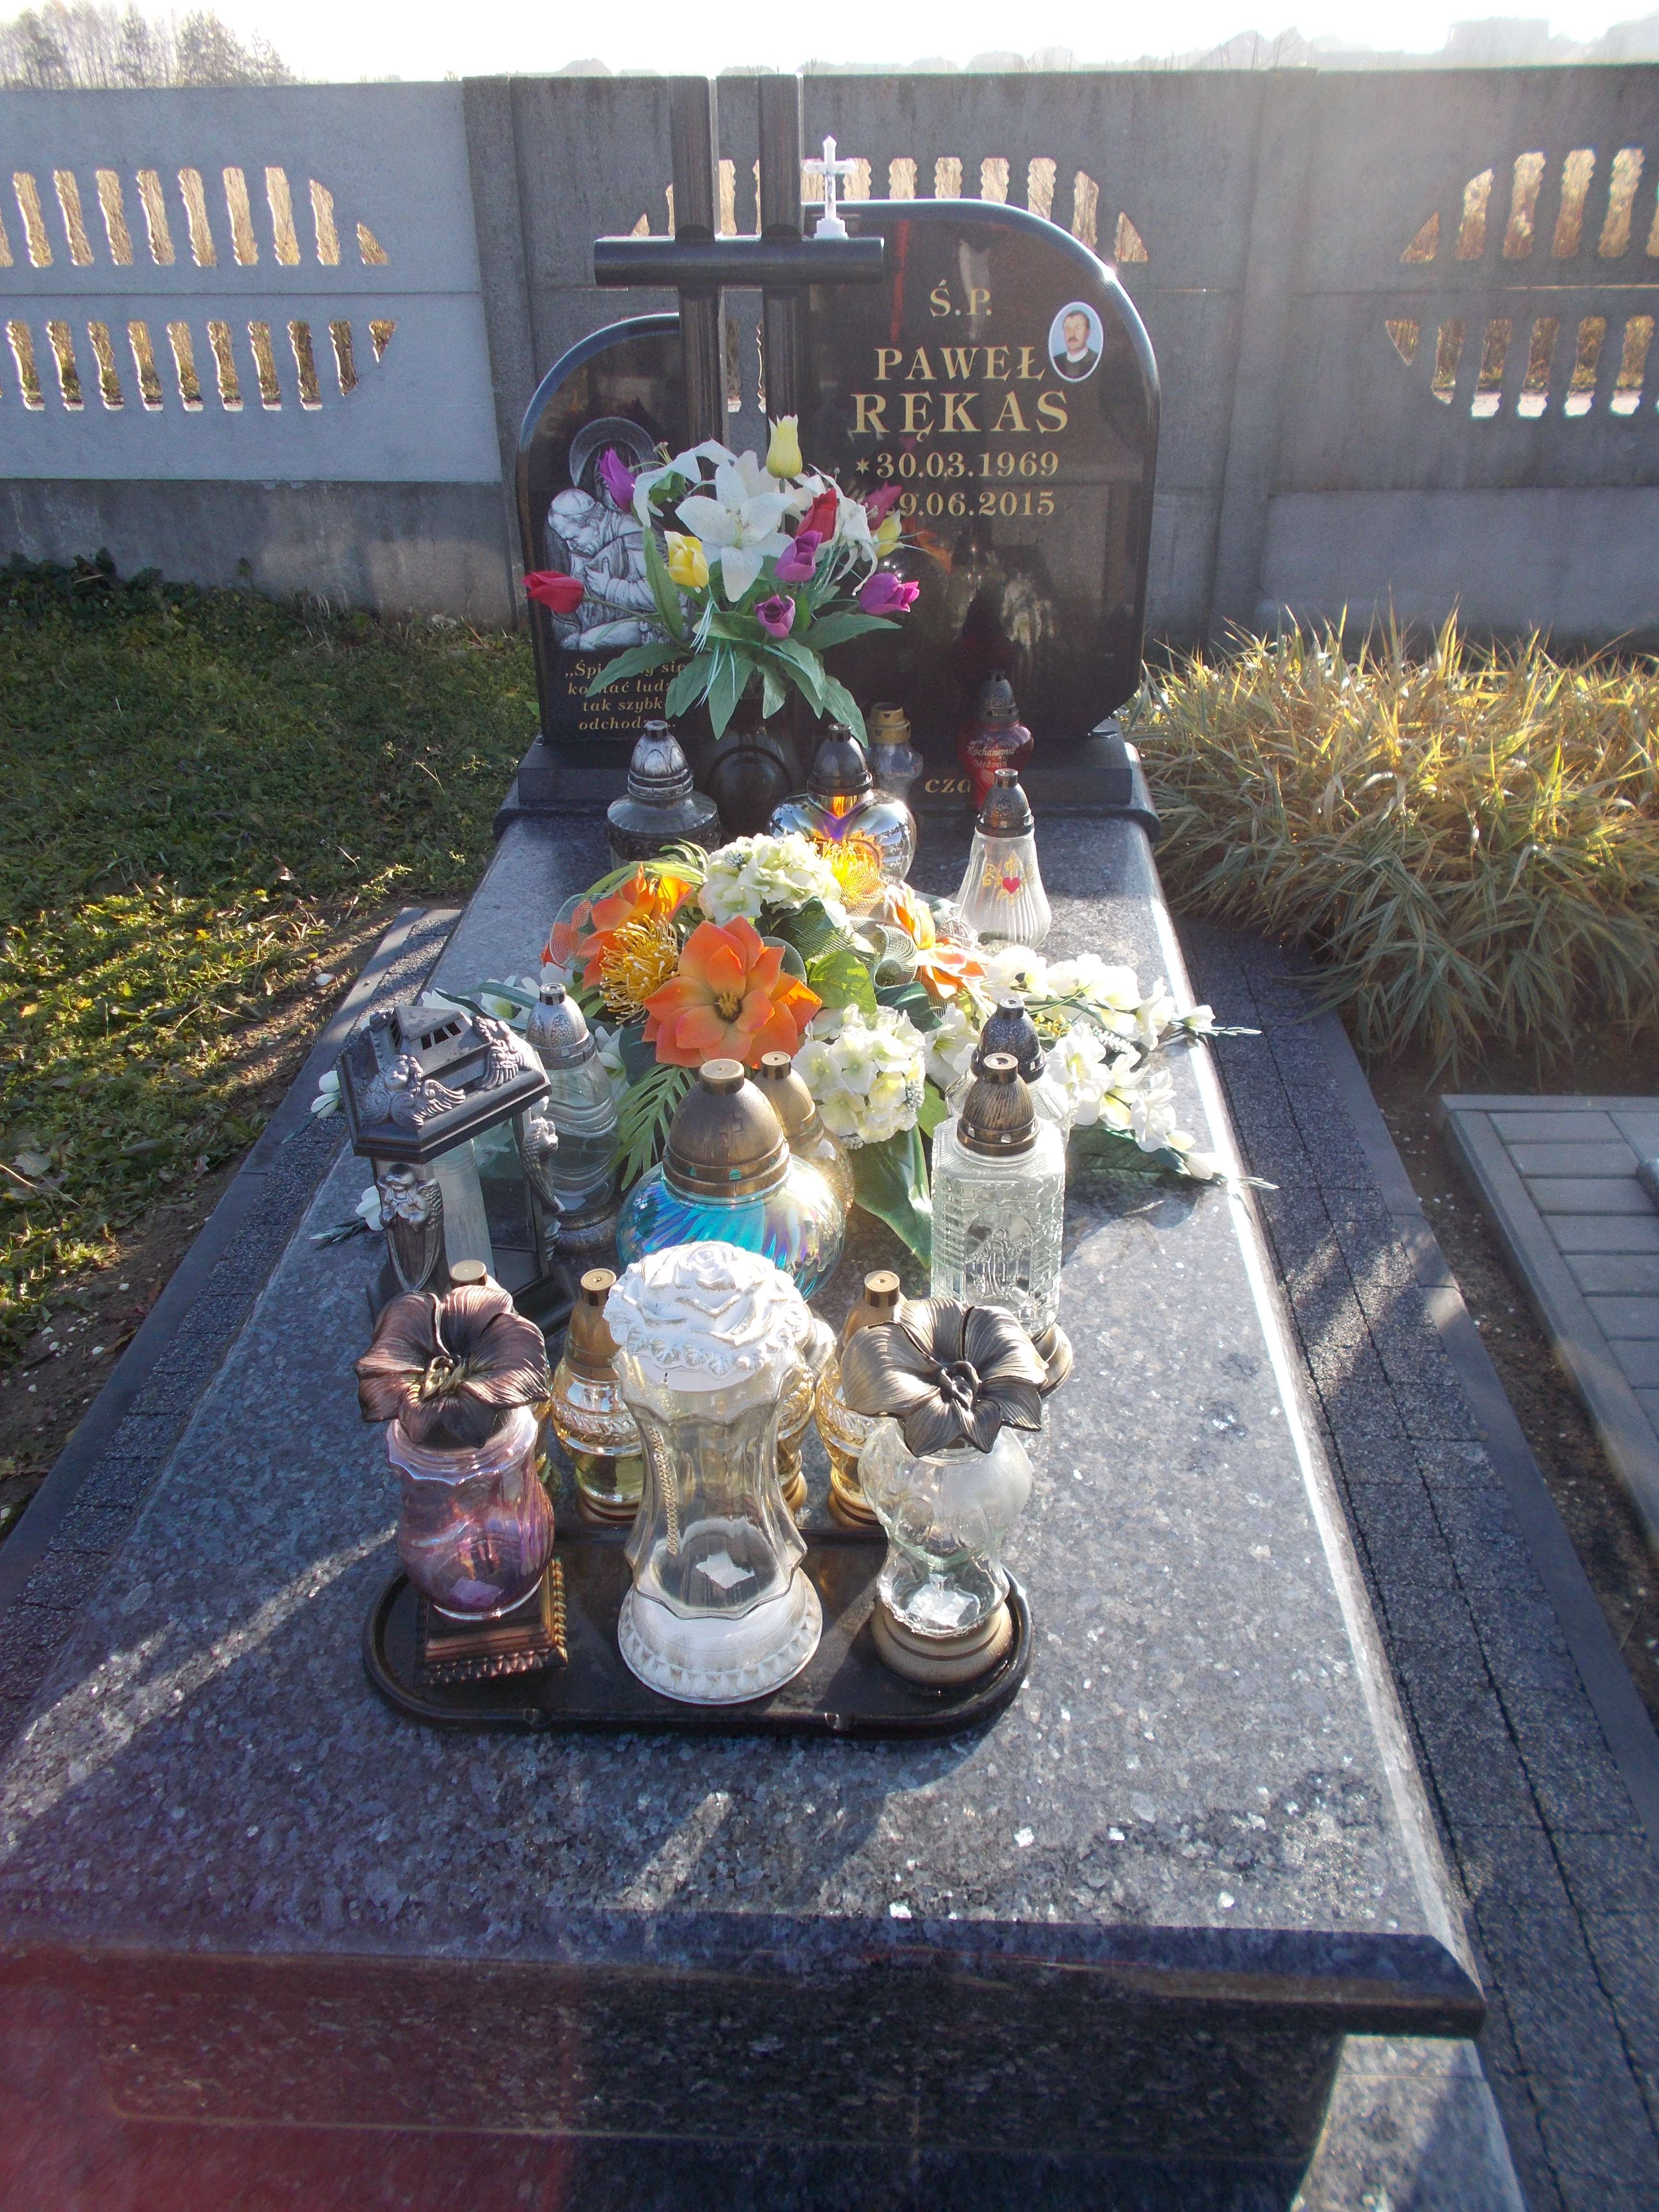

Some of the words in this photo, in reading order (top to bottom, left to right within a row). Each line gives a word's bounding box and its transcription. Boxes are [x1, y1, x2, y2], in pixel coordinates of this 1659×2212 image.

[874, 346, 1046, 381] PAWEŁ
[850, 389, 1068, 442] RĘKAS
[886, 491, 1055, 516] 9.06.2015
[568, 681, 629, 695] koać
[582, 698, 611, 712] tak
[618, 697, 662, 713] szybk
[925, 779, 971, 793] cza
